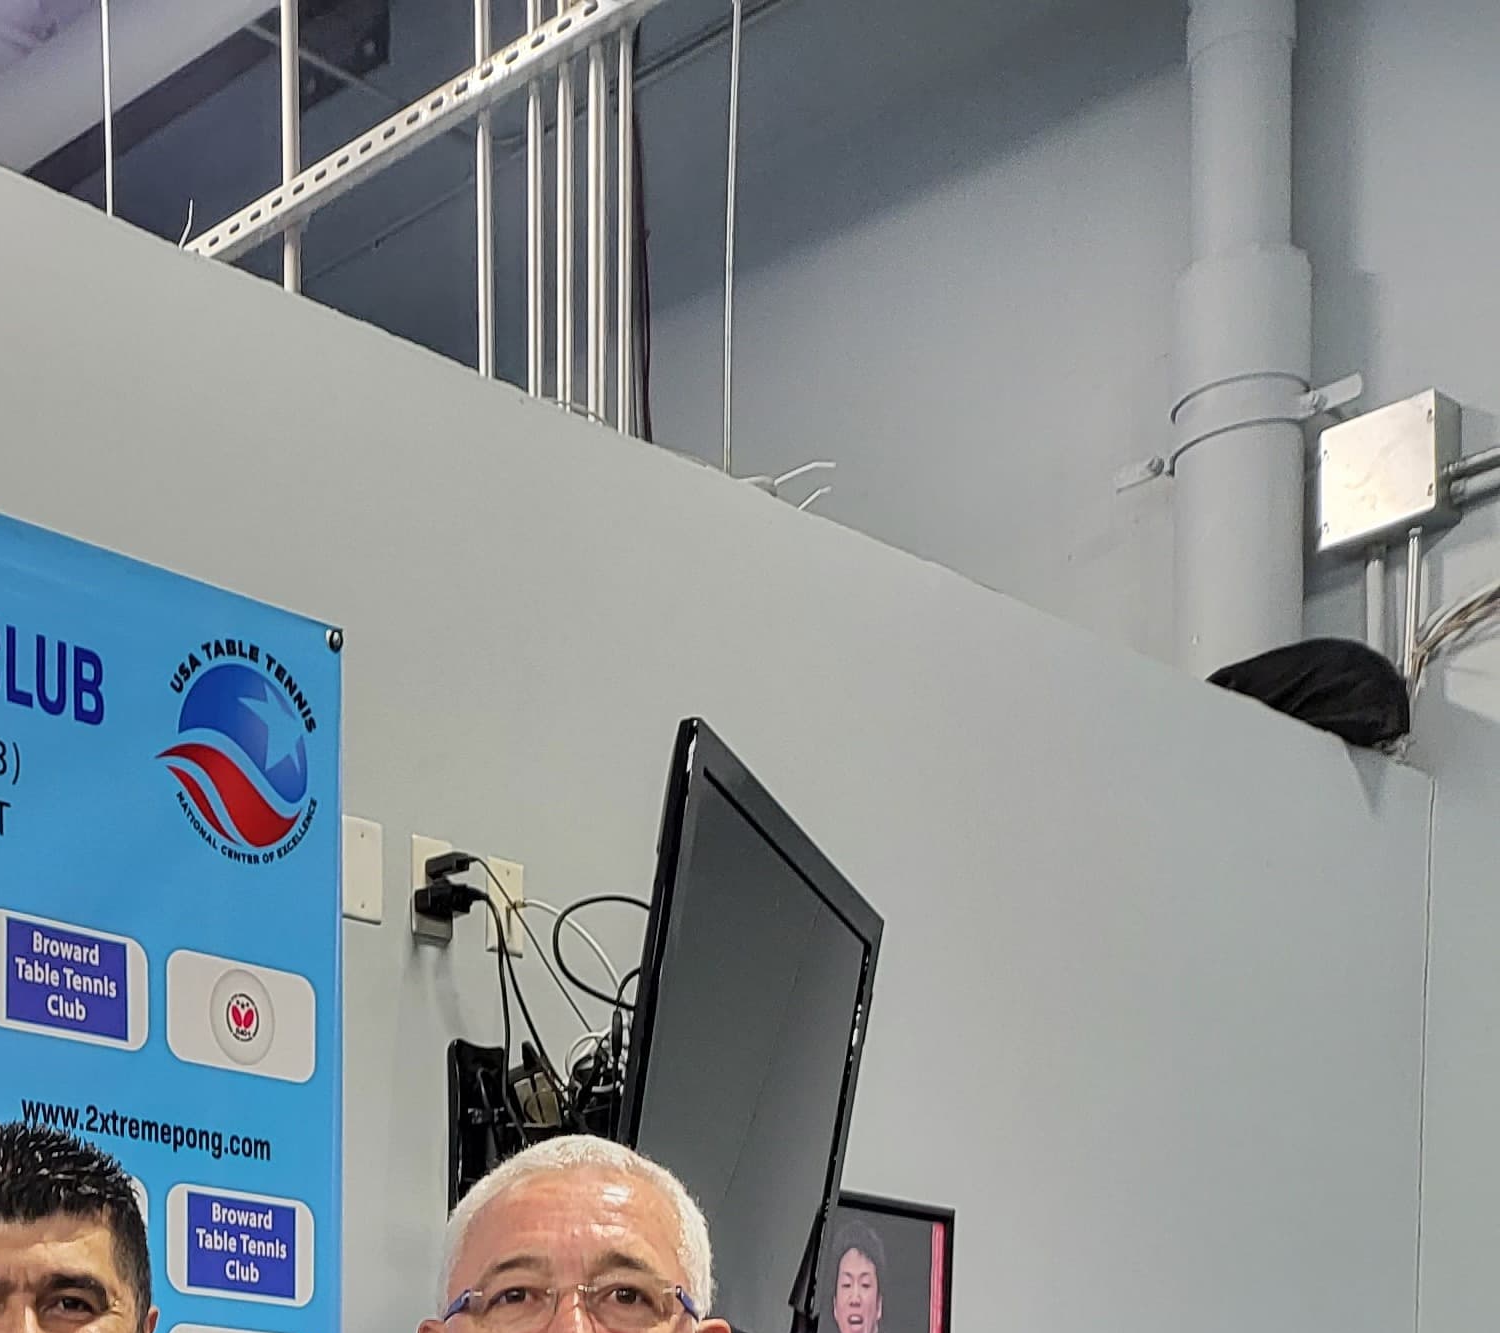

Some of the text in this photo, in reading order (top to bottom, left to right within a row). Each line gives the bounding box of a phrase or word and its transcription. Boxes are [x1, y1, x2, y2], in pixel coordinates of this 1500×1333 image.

[170, 639, 316, 734] USA TABLE TENNIS
[176, 791, 318, 865] NATIONAL CENTER OF EXCELLENCE
[32, 930, 100, 967] Broward
[15, 956, 117, 998] Table Tennis
[47, 995, 86, 1022] Club
[21, 1099, 271, 1161] www.2xtremepong.com
[211, 1202, 273, 1231] Broward
[196, 1227, 288, 1260] Table Tennis
[225, 1258, 260, 1284] Club
